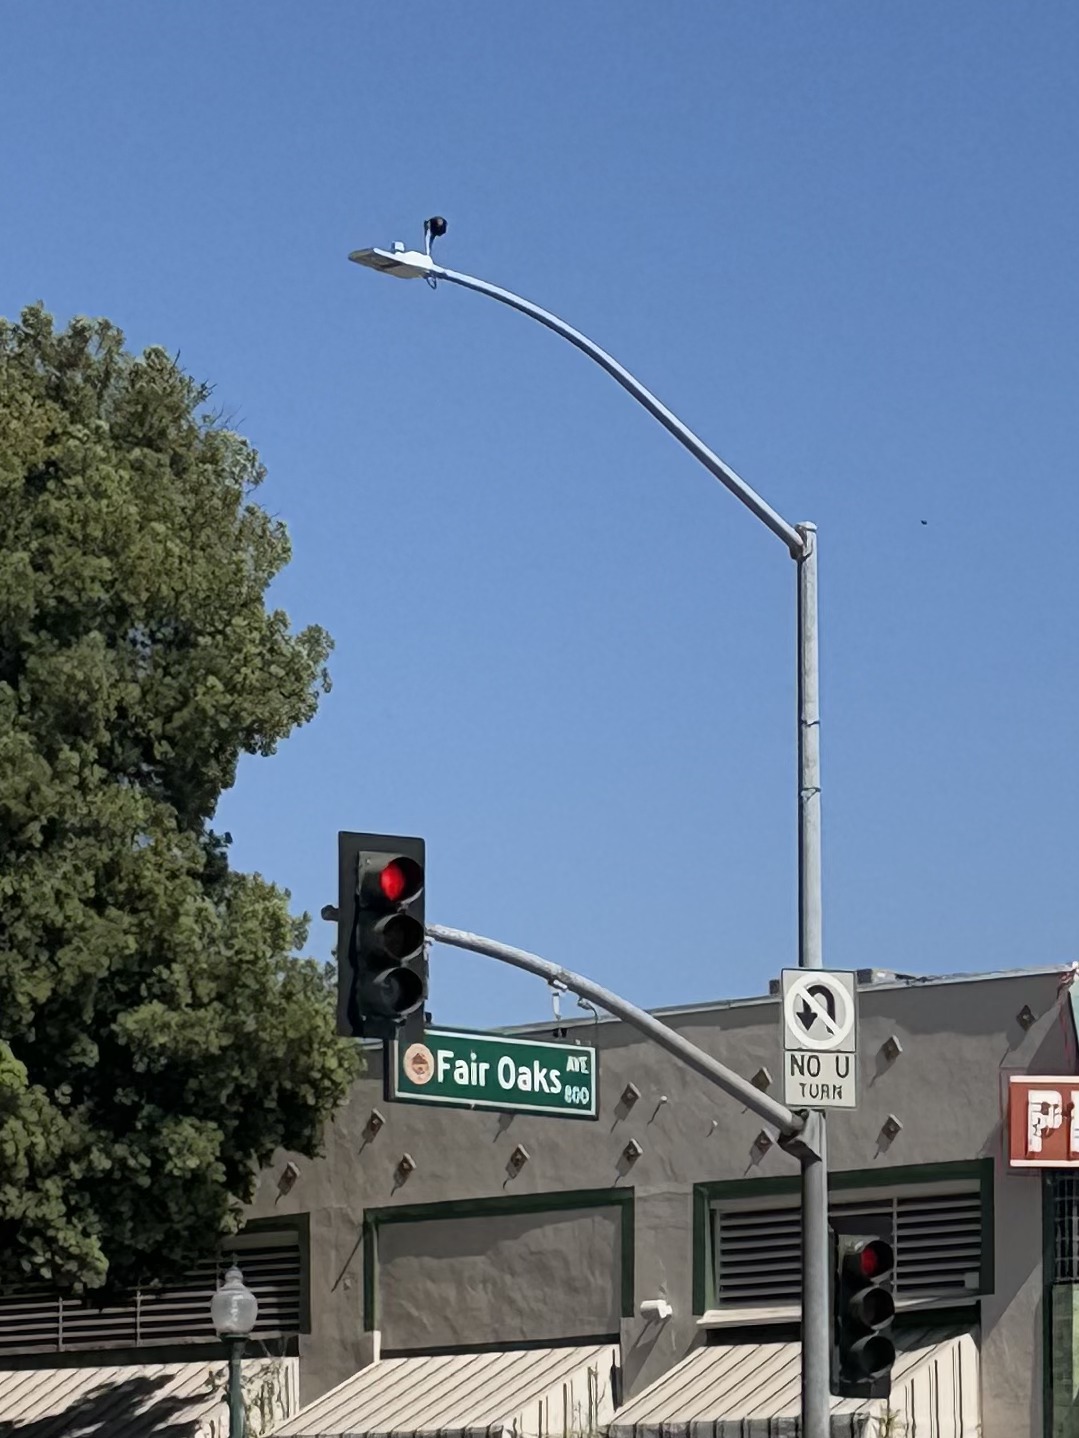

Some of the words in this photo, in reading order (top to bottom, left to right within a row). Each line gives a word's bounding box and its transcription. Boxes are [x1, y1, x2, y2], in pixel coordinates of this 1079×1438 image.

[437, 1049, 490, 1087] Fair
[497, 1055, 562, 1094] Oaks
[566, 1055, 590, 1075] AVE
[790, 1053, 821, 1077] NO
[836, 1055, 849, 1078] U
[799, 1082, 843, 1100] TURN
